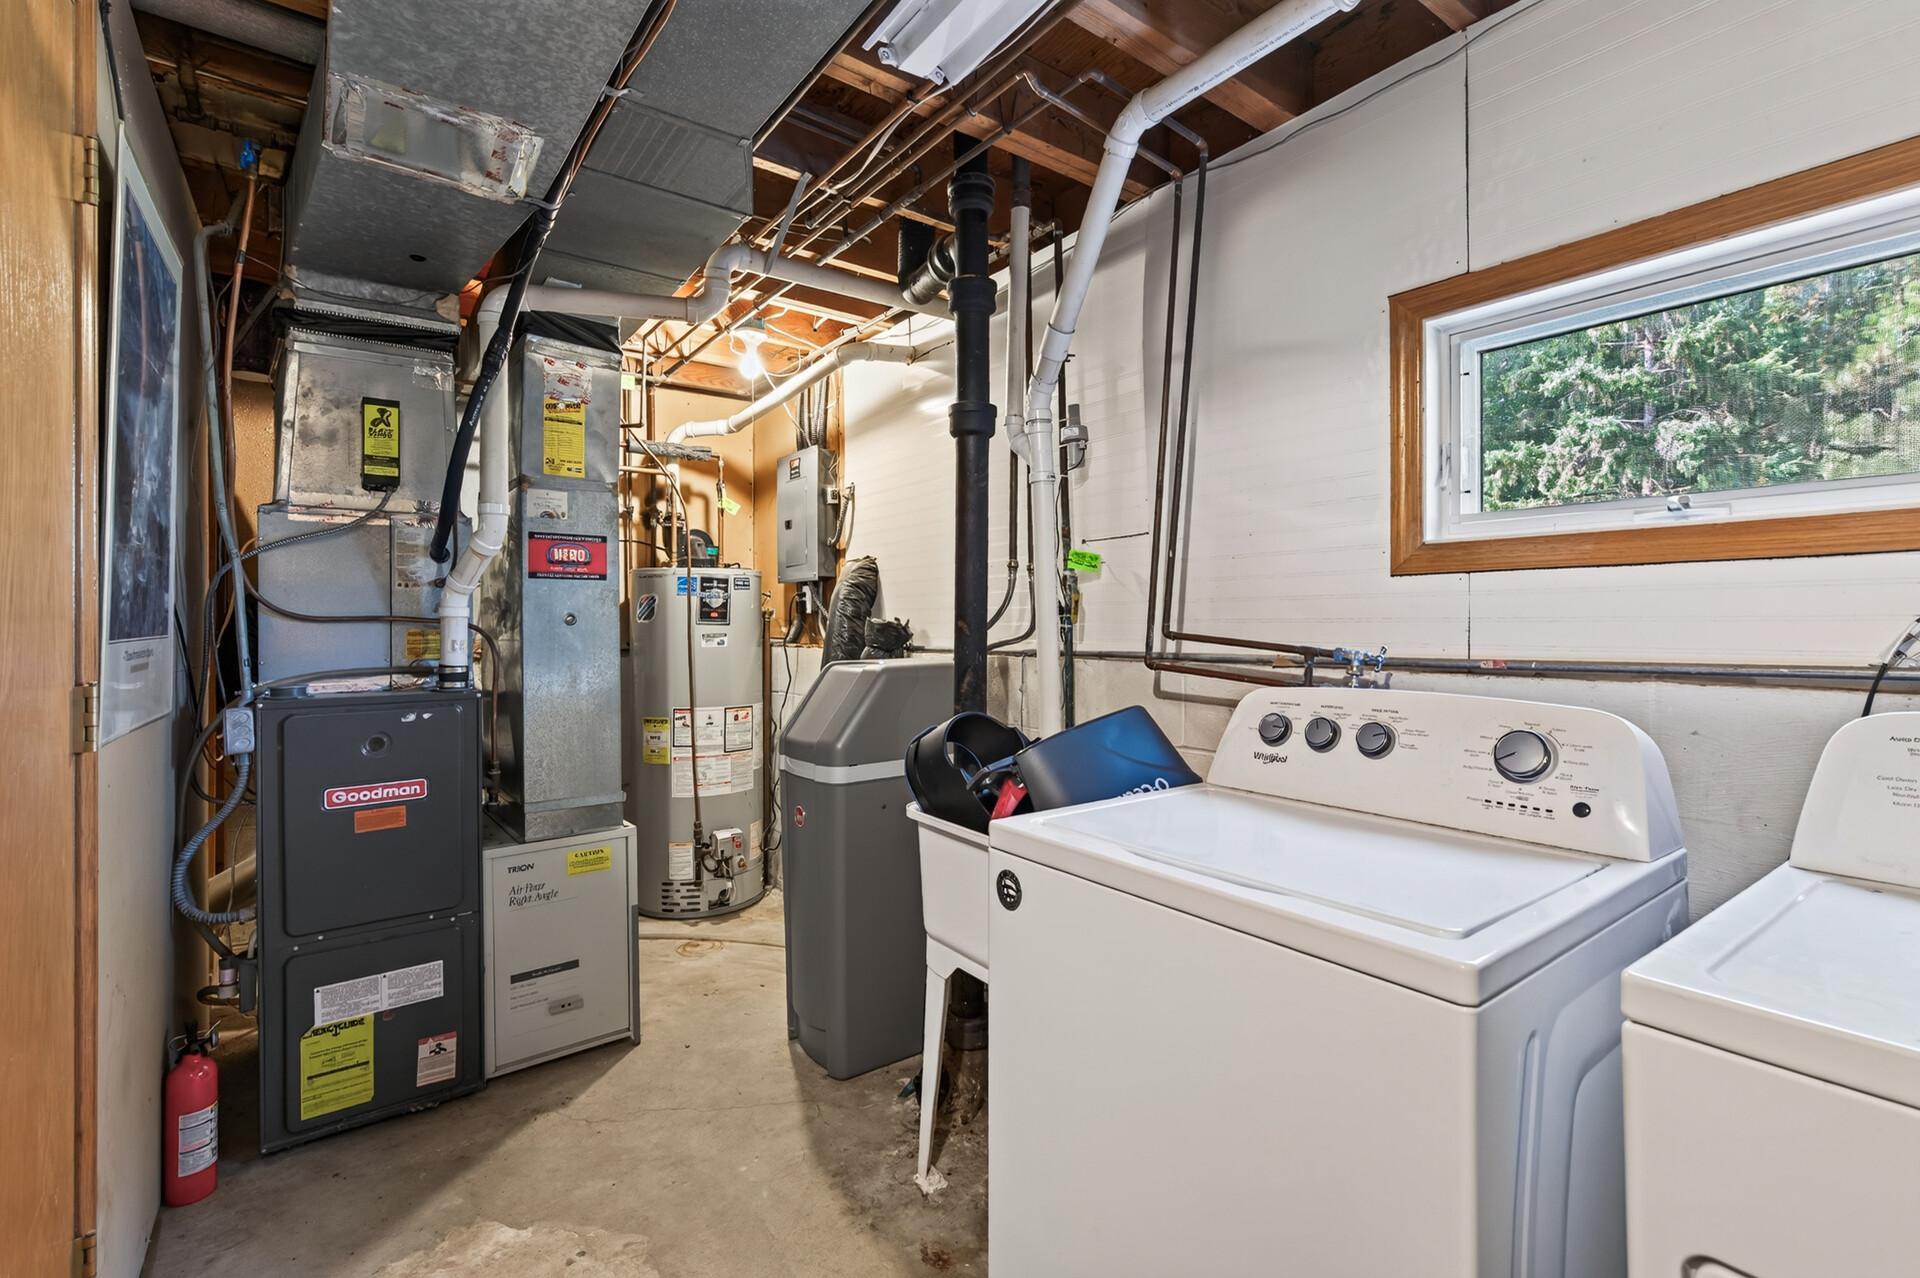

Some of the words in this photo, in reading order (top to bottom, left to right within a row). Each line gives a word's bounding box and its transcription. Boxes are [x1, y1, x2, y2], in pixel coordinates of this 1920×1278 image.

[1253, 751, 1288, 765] Whirlpool
[331, 784, 421, 804] Goodman
[507, 862, 535, 874] TRION
